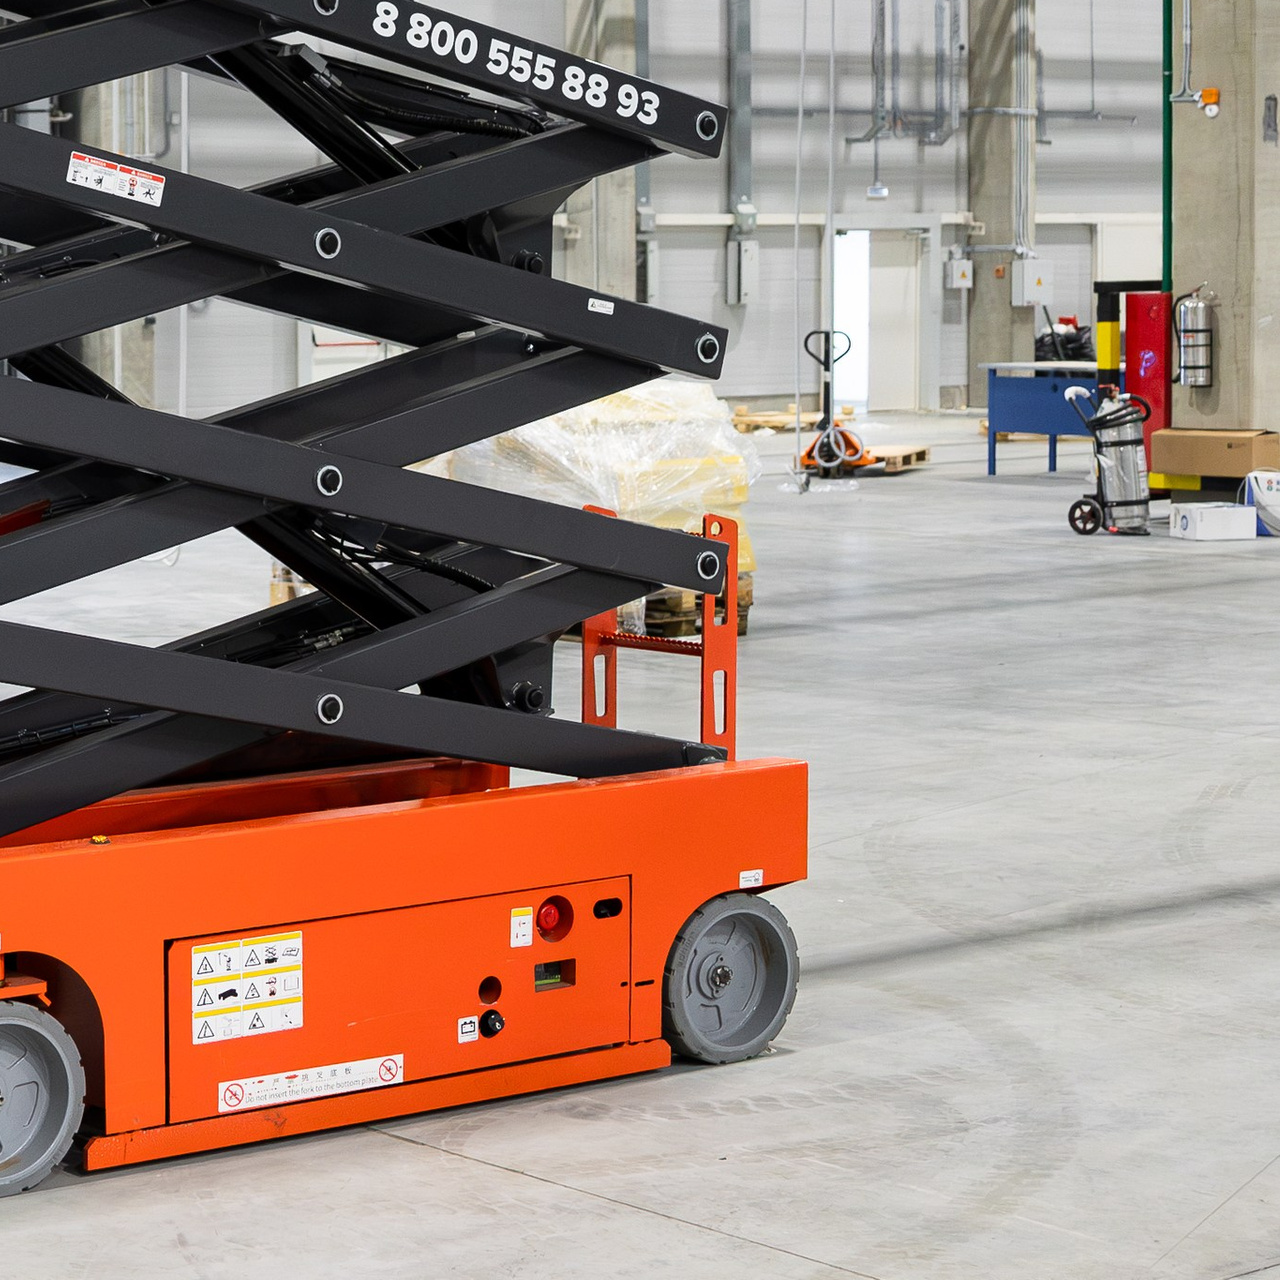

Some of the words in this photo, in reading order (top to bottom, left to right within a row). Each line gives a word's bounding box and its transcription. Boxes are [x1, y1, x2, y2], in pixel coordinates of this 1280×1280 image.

[372, 1, 399, 37] 8
[406, 12, 478, 64] 800
[486, 38, 556, 90] 555
[561, 65, 609, 108] 88
[616, 83, 660, 125] 93
[256, 1093, 268, 1101] not
[269, 1090, 288, 1099] insert
[289, 1088, 300, 1096] the
[324, 1082, 334, 1091] the
[336, 1079, 361, 1089] bottom
